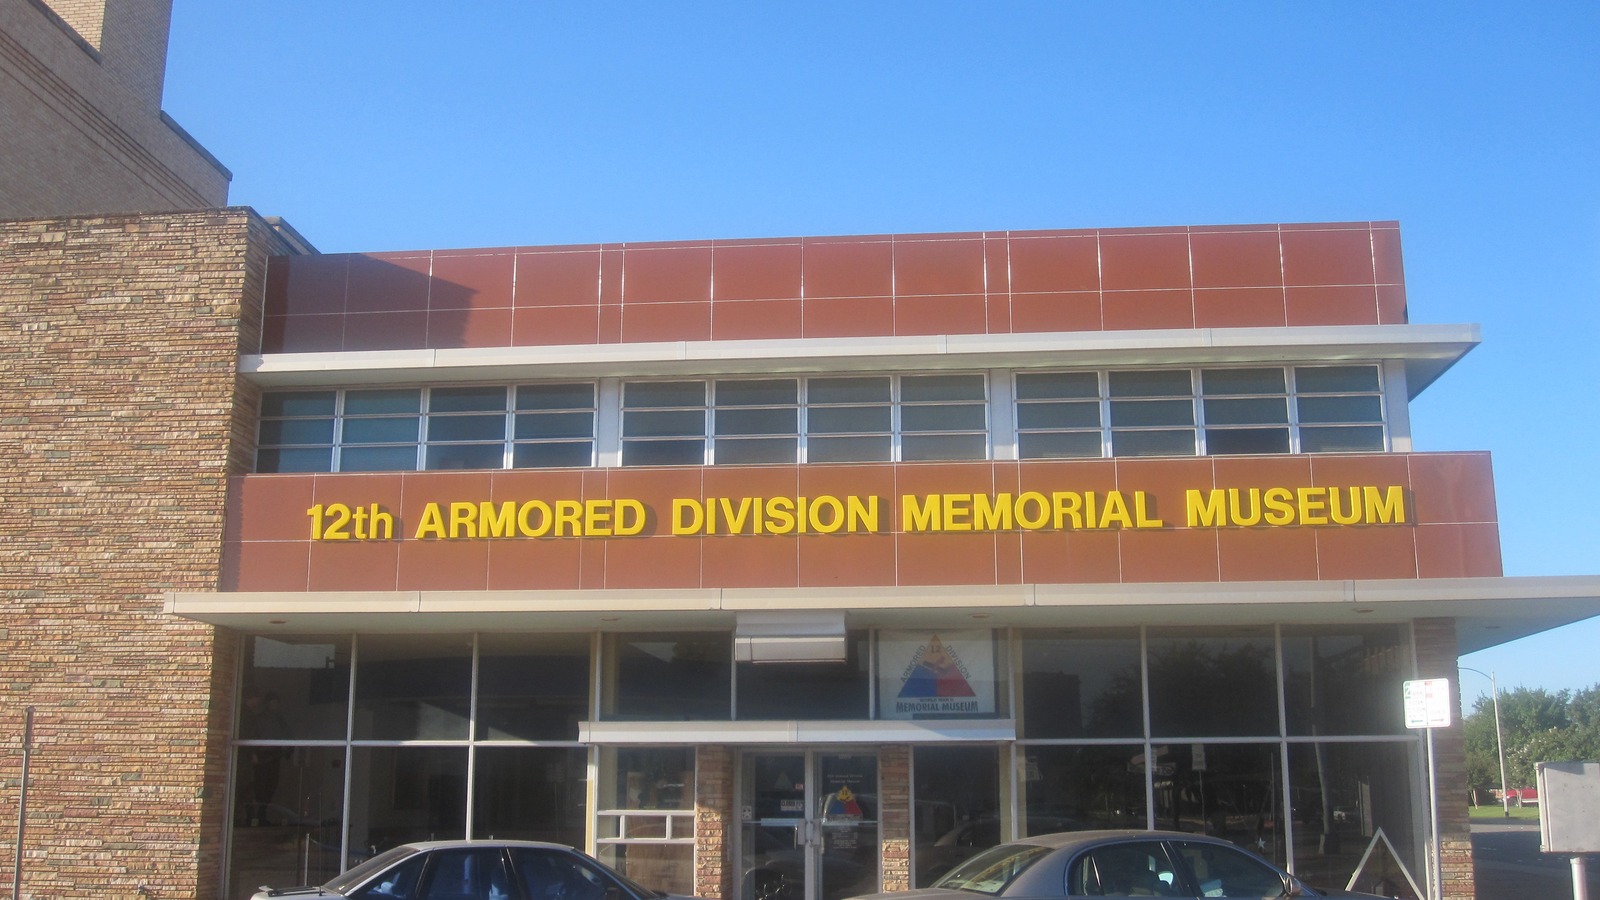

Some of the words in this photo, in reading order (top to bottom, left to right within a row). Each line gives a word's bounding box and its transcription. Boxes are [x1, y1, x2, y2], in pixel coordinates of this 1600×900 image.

[307, 503, 394, 541] 12th
[415, 498, 647, 539] ARMORED
[671, 494, 880, 536] DIVISION
[901, 490, 1164, 533] MEMORIAL
[1185, 485, 1405, 528] MUSEUM
[900, 645, 926, 683] ARMORED
[946, 645, 972, 679] DIVISION
[896, 702, 939, 713] MEMORIAL
[942, 701, 978, 712] MUSEUM
